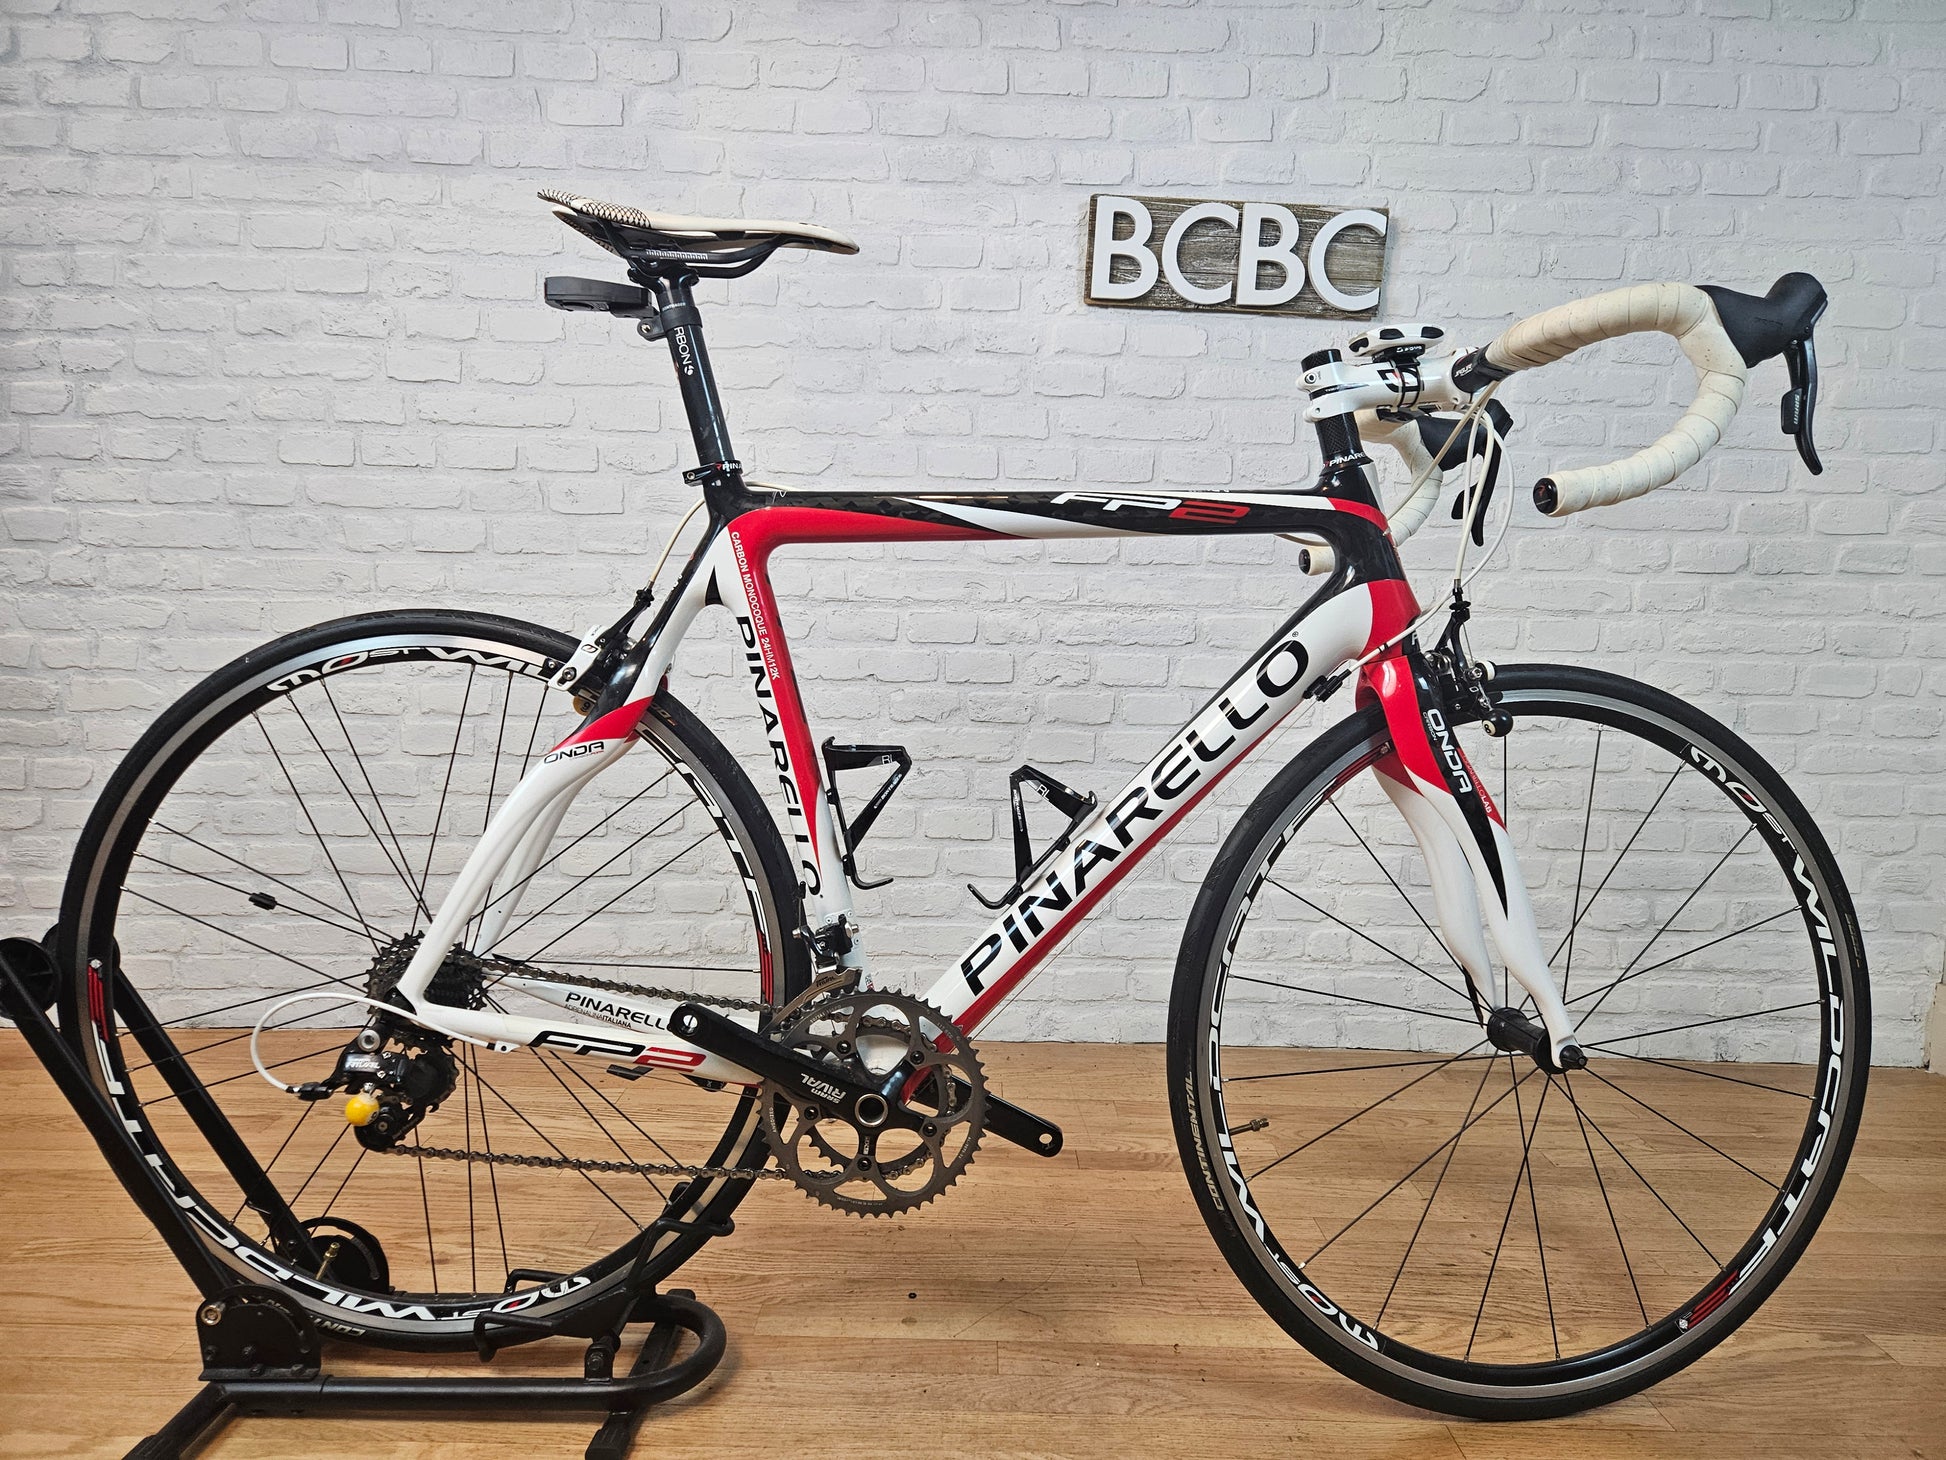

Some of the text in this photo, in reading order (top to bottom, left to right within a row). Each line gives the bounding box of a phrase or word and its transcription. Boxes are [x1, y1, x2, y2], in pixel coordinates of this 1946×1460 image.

[1090, 195, 1387, 312] BCBC
[674, 326, 693, 365] RBON
[1050, 492, 1251, 524] FP2
[731, 531, 781, 680] CARBON MONOCOQUE 24HM12K
[543, 741, 605, 764] ONDA
[1427, 708, 1473, 794] ONDA
[960, 640, 1309, 997] PINARELLO
[565, 991, 672, 1032] PINARELL
[529, 1030, 707, 1073] FP2
[800, 1073, 847, 1100] RIVAL
[1183, 1071, 1225, 1212] CONTINENTAL
